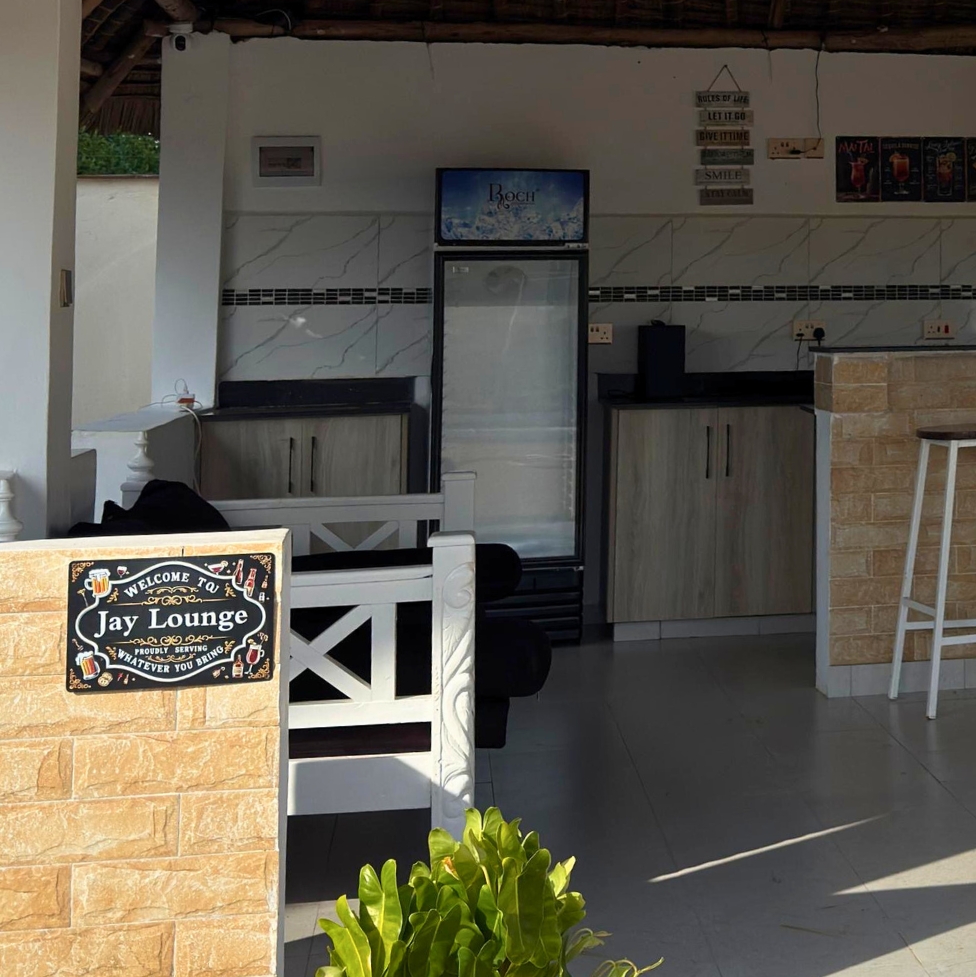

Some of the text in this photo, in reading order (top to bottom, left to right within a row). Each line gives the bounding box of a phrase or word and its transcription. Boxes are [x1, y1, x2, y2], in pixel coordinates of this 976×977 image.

[698, 94, 721, 103] RULES
[722, 94, 731, 102] OF
[708, 112, 746, 120] LET IT GO
[699, 131, 749, 141] GIVE IT TIME
[704, 170, 742, 180] SMILE
[123, 571, 220, 598] WELCOME TO
[93, 608, 248, 638] Jay Lounge
[135, 645, 208, 655] PROUDLY SERVING
[117, 645, 225, 673] WHATEVER YOU BRING
